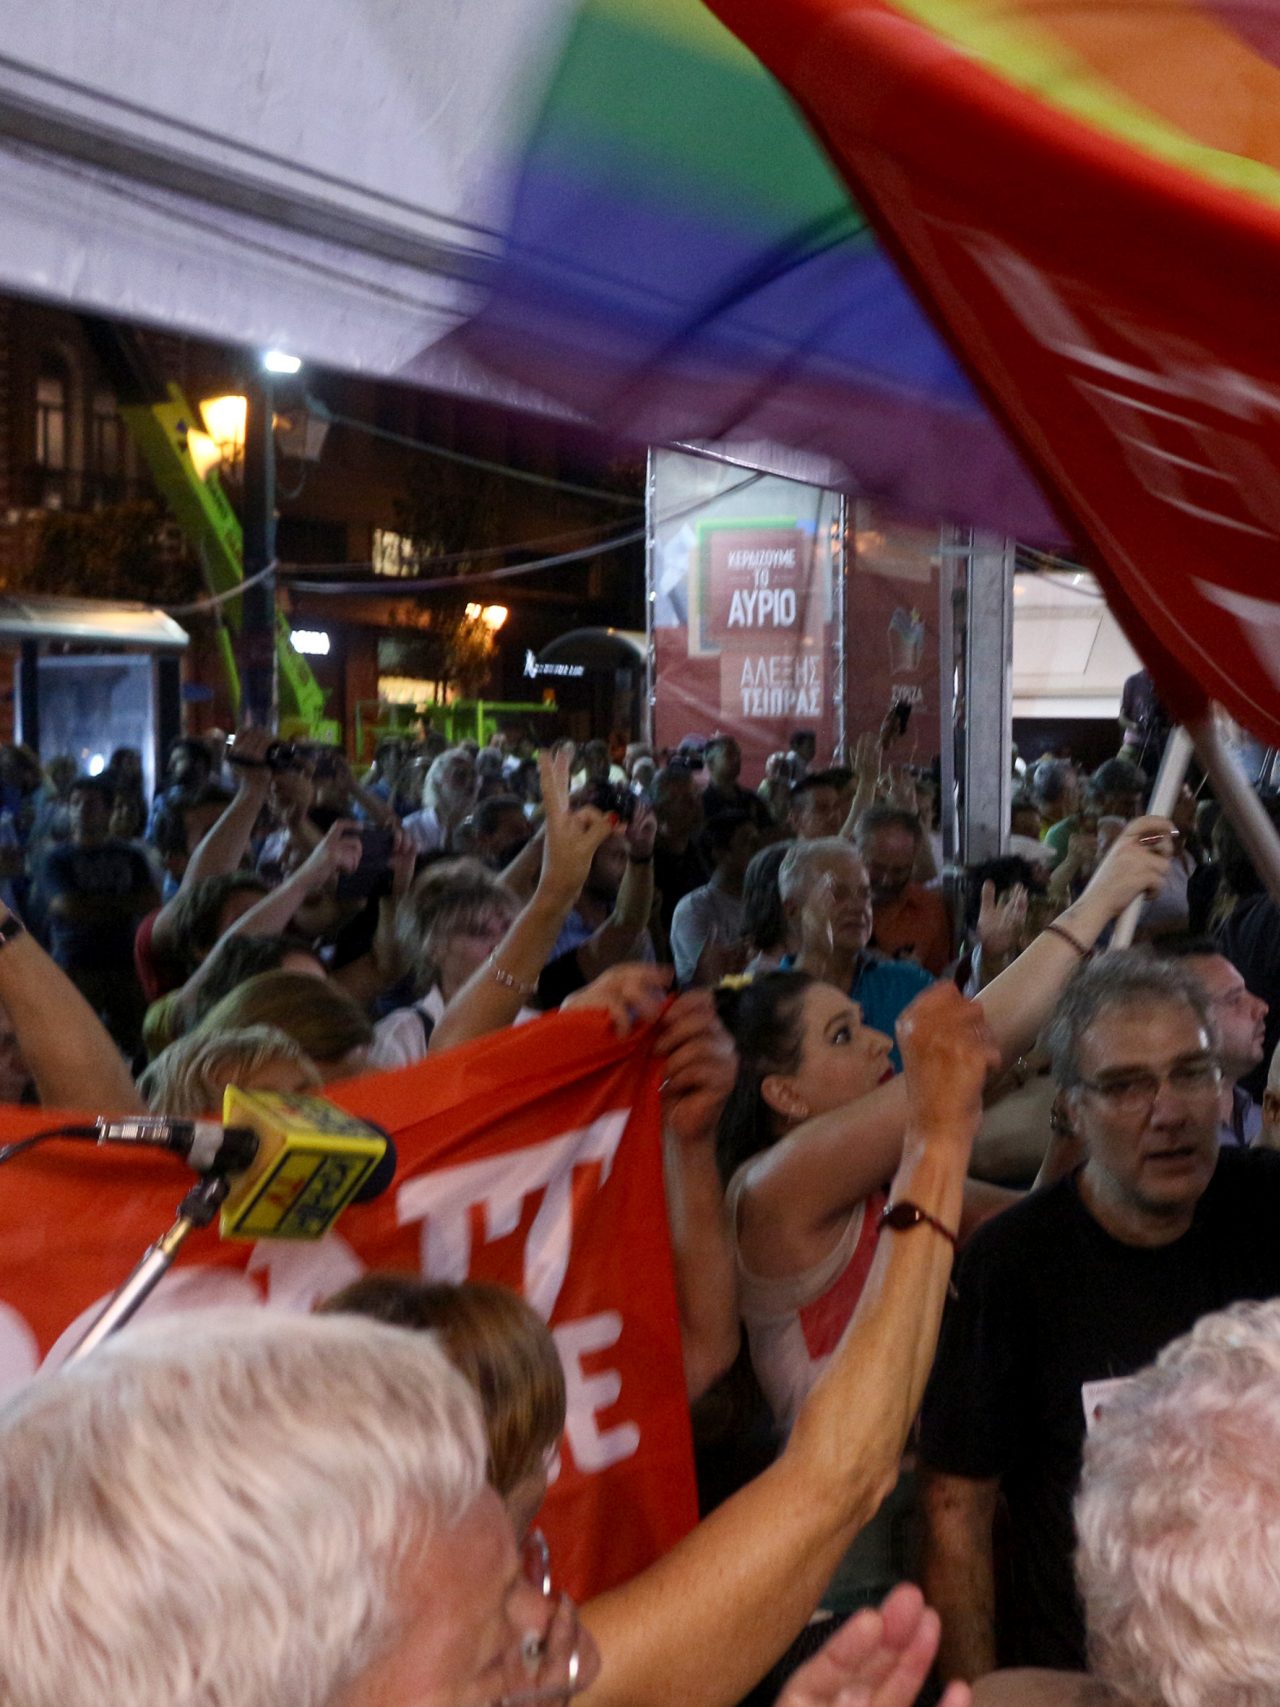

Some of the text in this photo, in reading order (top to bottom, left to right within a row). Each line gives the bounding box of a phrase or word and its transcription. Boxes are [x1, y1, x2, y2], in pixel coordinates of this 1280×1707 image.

[754, 568, 769, 588] ΤΟ
[727, 588, 797, 628] ΑΥΡΙΟ
[740, 655, 820, 688] ΑΛΕΞΗΣ
[741, 687, 821, 718] ΤΣΙΠΡΑΣ
